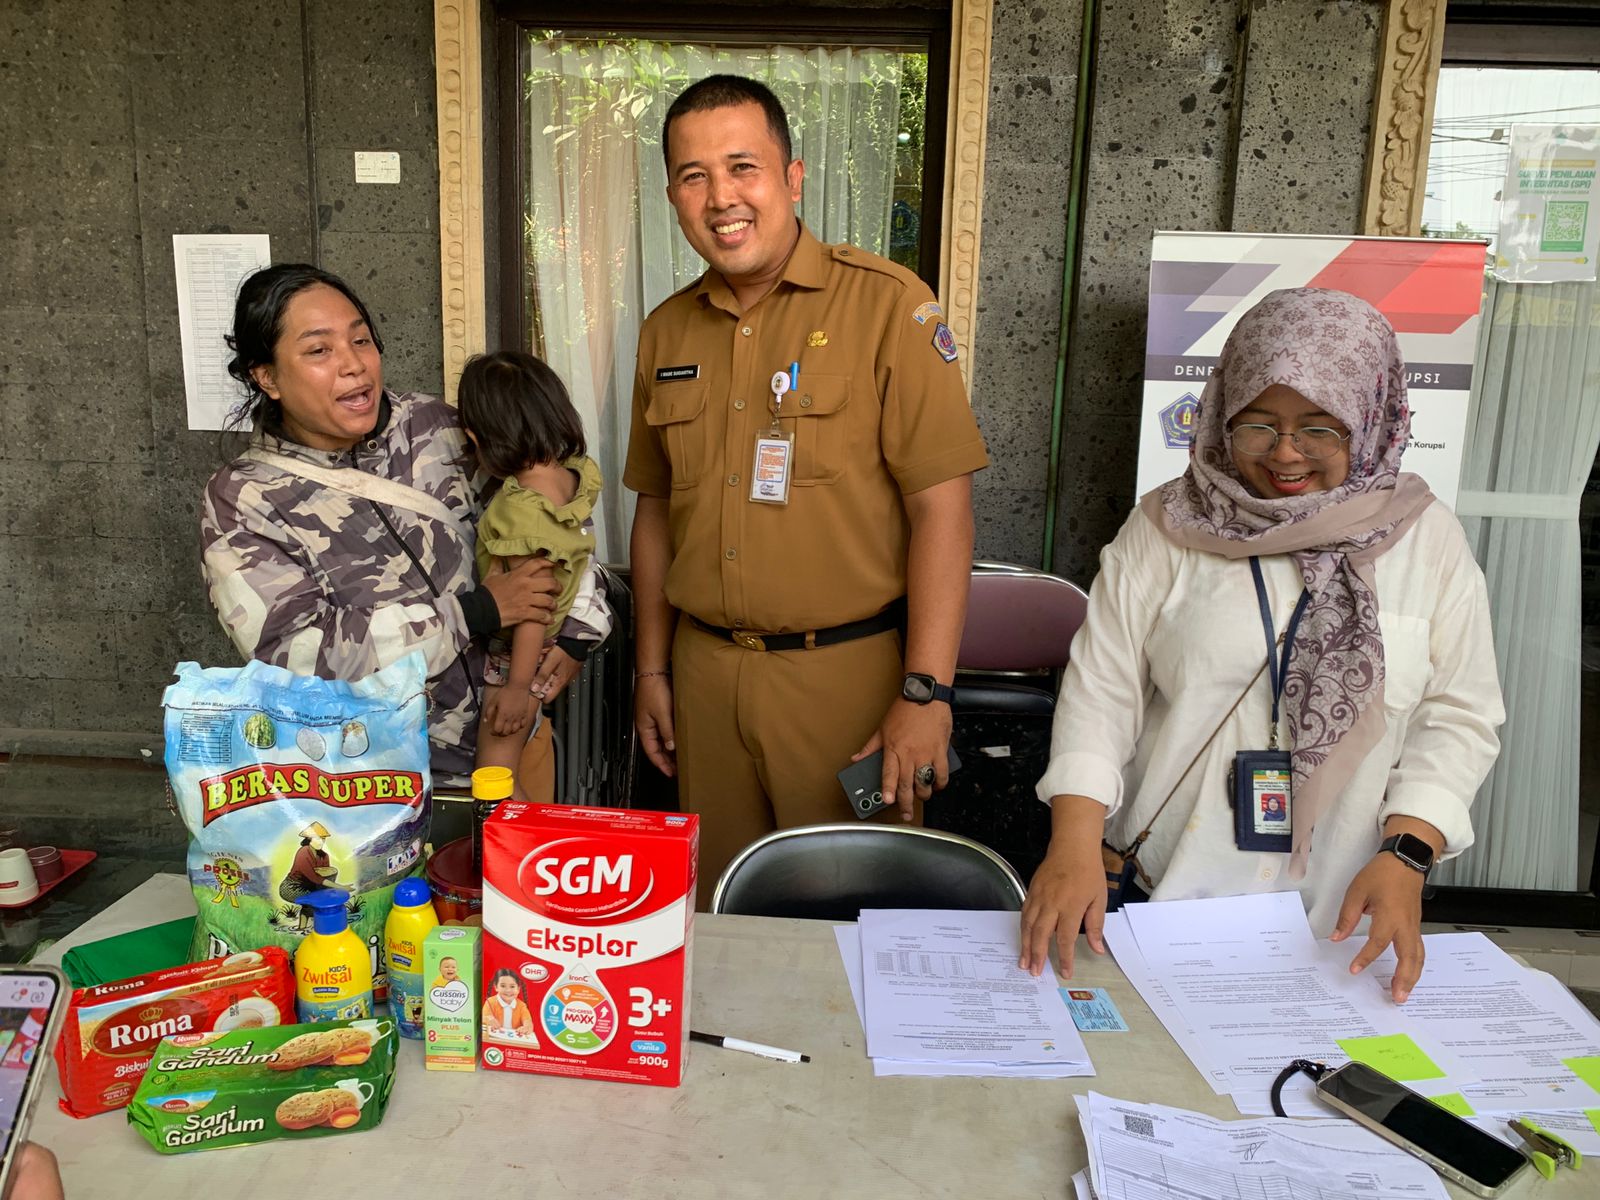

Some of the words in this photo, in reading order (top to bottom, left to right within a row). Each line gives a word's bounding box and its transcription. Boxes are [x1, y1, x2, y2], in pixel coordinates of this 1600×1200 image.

[1550, 170, 1596, 178] PENILAIAN
[1570, 180, 1592, 189] (SPI)
[1174, 365, 1215, 377] DENP
[1405, 372, 1441, 384] UPSI
[1413, 441, 1446, 450] Korupsi
[207, 769, 310, 811] BERAS
[318, 774, 416, 802] SUPER
[534, 854, 633, 896] SGM
[527, 928, 638, 958] Eksplor
[303, 967, 352, 985] Zwitsal
[328, 965, 348, 973] KIDS
[95, 979, 145, 996] Roma
[433, 989, 467, 999] Cussons
[440, 998, 462, 1007] baby
[627, 986, 672, 1028] 3+
[426, 1016, 452, 1024] Minyak
[109, 1012, 194, 1049] Roma
[177, 1034, 201, 1043] Roma
[186, 1041, 254, 1059] Sari
[157, 1053, 279, 1071] Gandum
[639, 1055, 669, 1068] 900g
[183, 1105, 237, 1131] Sari
[165, 1118, 265, 1147] Gandum
